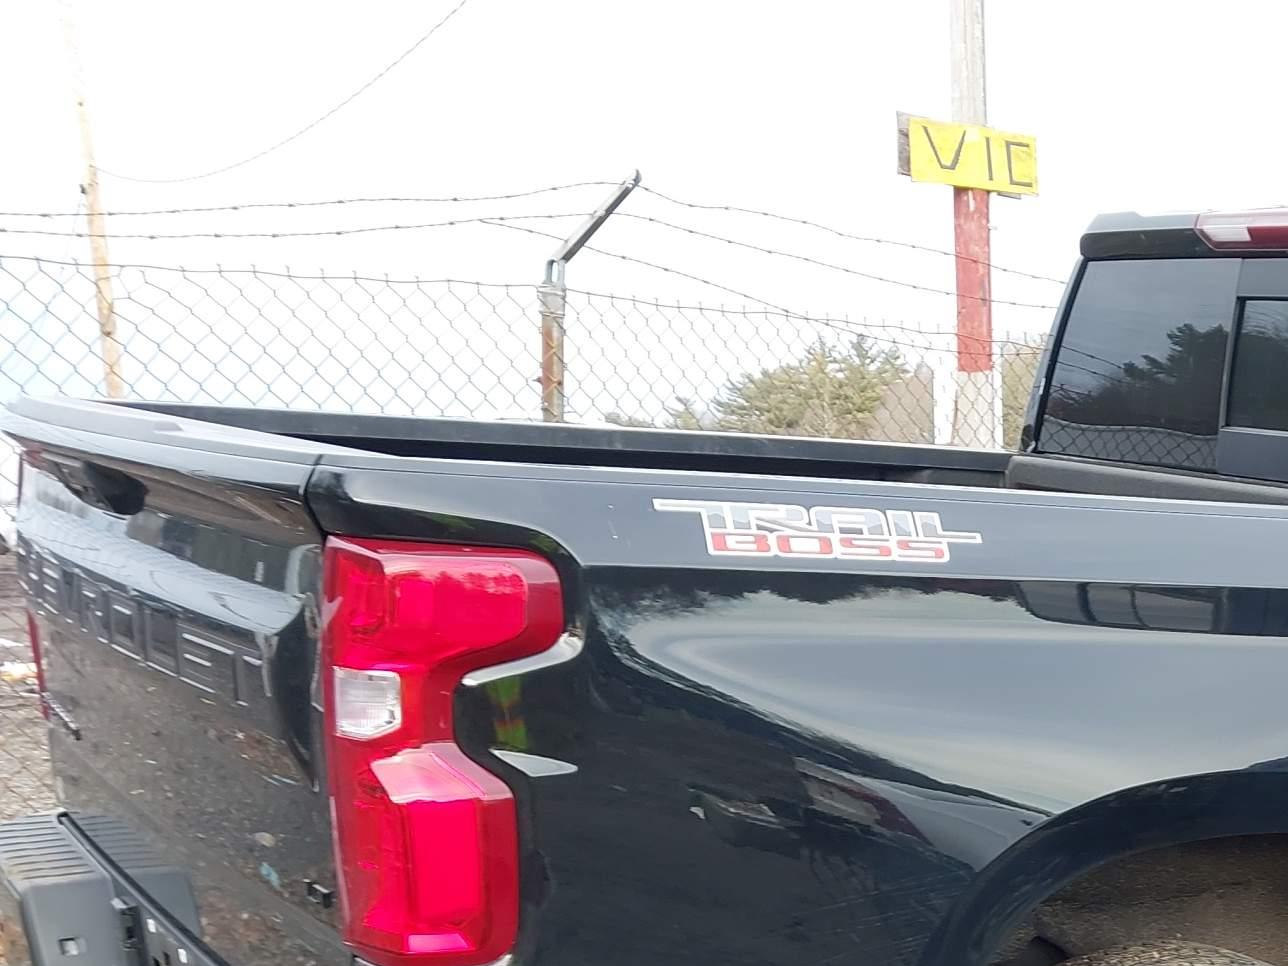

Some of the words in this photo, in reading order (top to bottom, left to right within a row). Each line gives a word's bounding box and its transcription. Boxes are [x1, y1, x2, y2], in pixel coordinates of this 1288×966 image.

[921, 125, 1034, 188] VIC
[652, 498, 983, 544] TRAIL
[707, 530, 951, 563] BOSS
